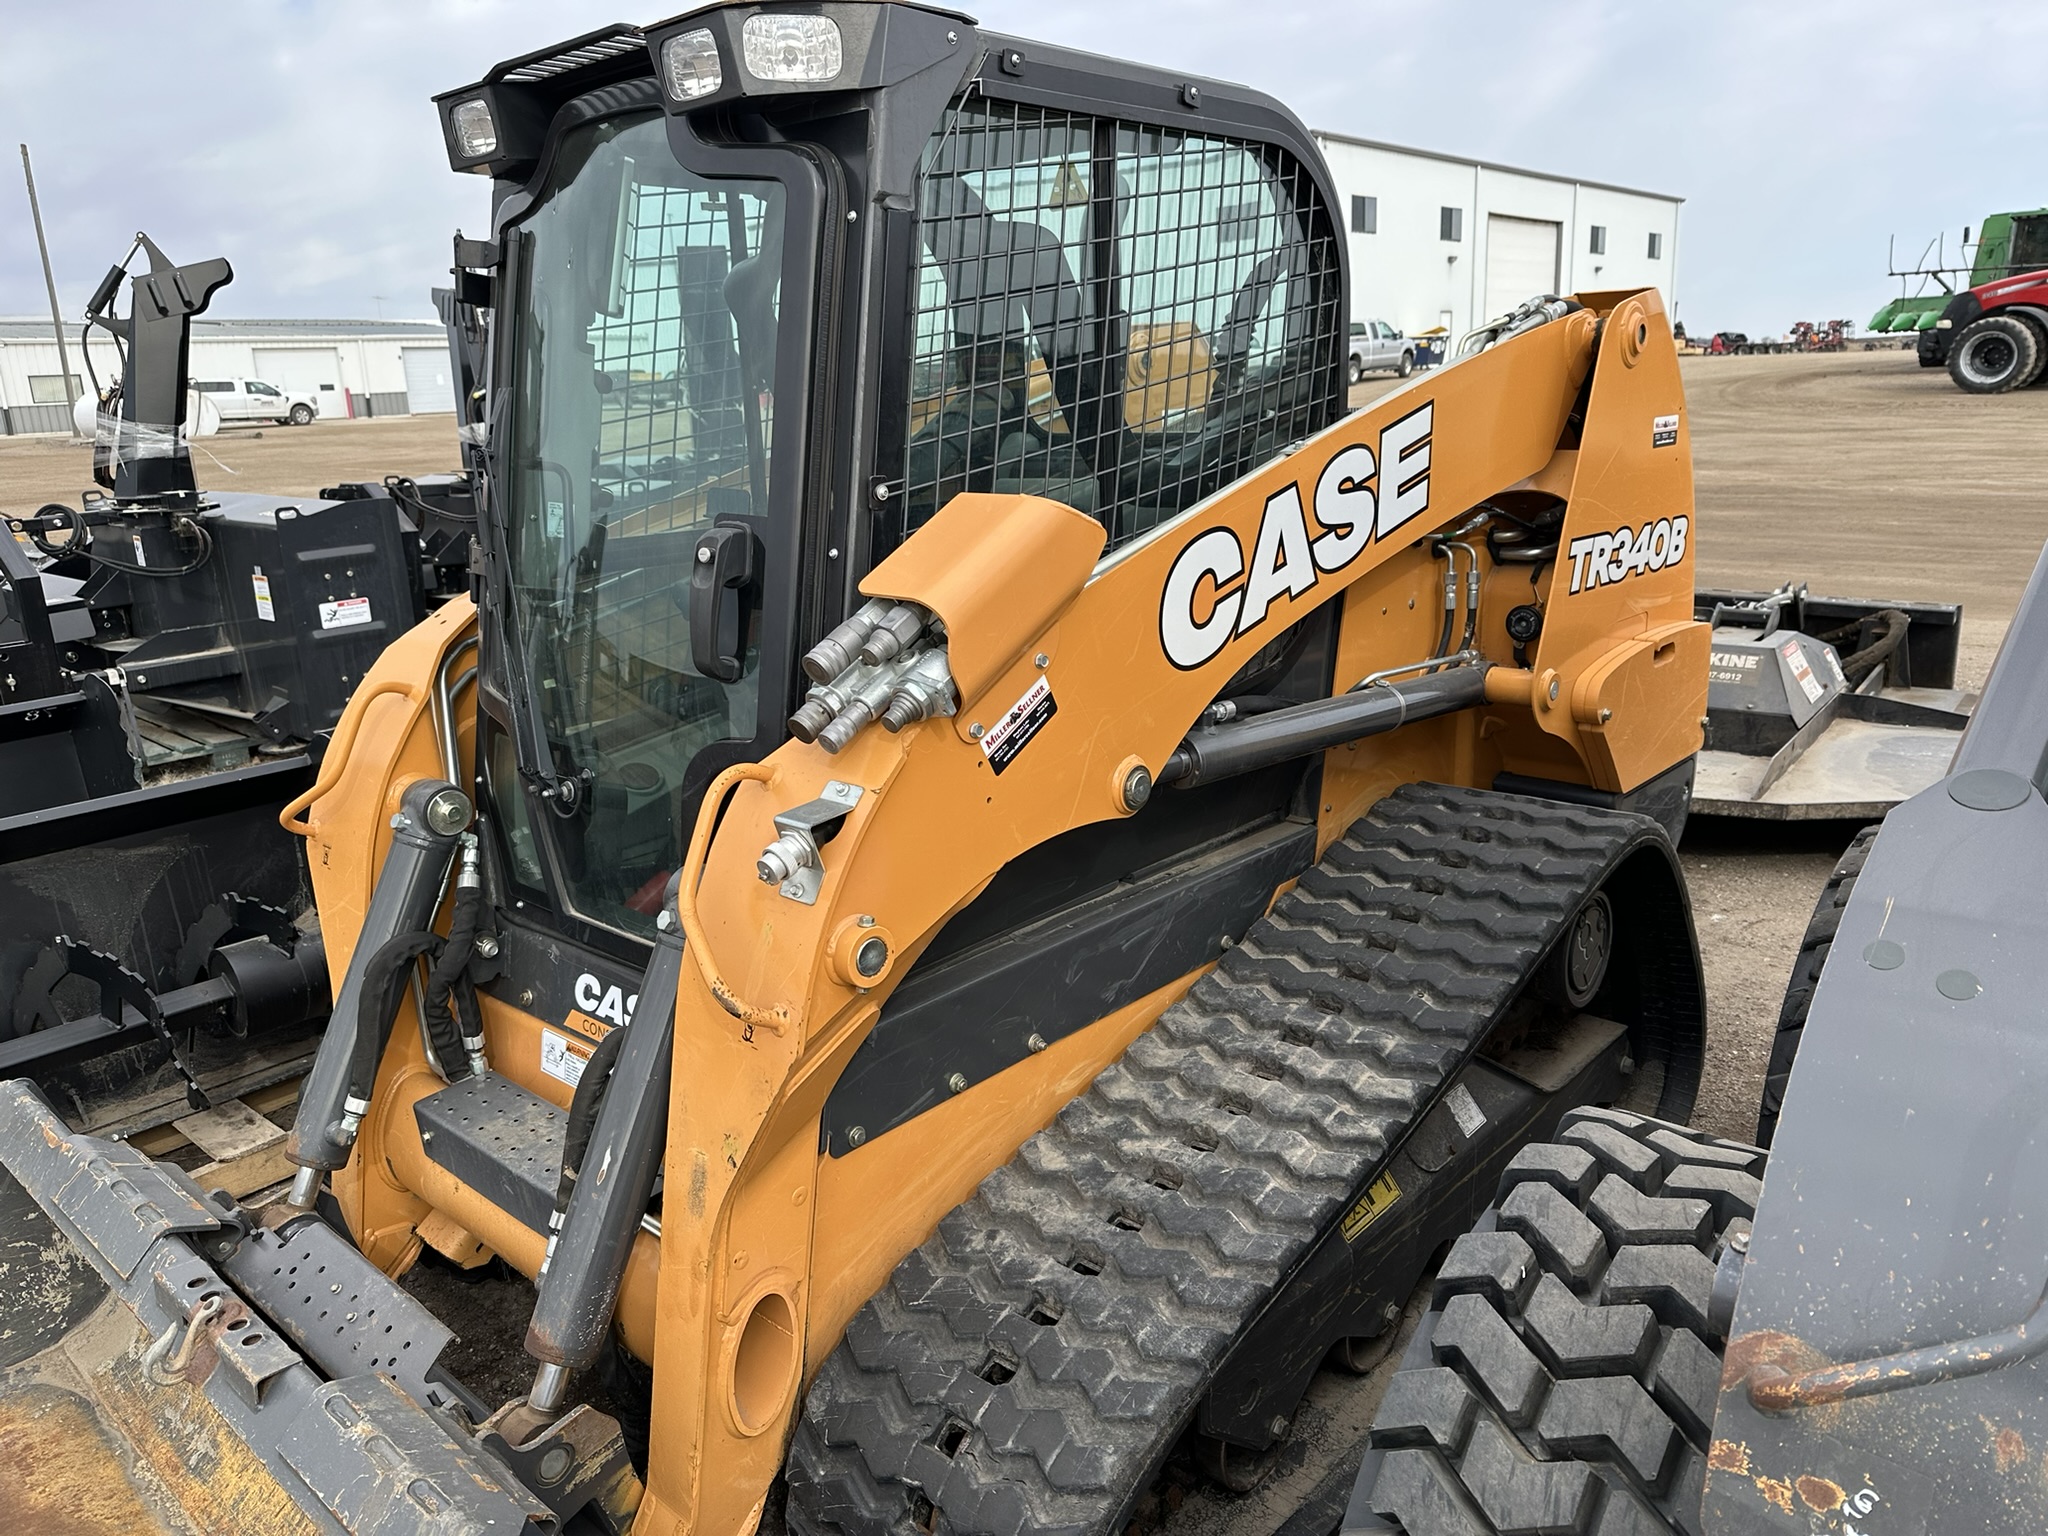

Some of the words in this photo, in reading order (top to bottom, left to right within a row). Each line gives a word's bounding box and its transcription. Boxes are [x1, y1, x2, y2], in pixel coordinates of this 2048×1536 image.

[1159, 398, 1434, 671] CASE
[1568, 514, 1689, 596] TR340B
[985, 721, 1013, 750] MILLER
[1017, 685, 1046, 716] SELLNER
[582, 1019, 609, 1038] CON
